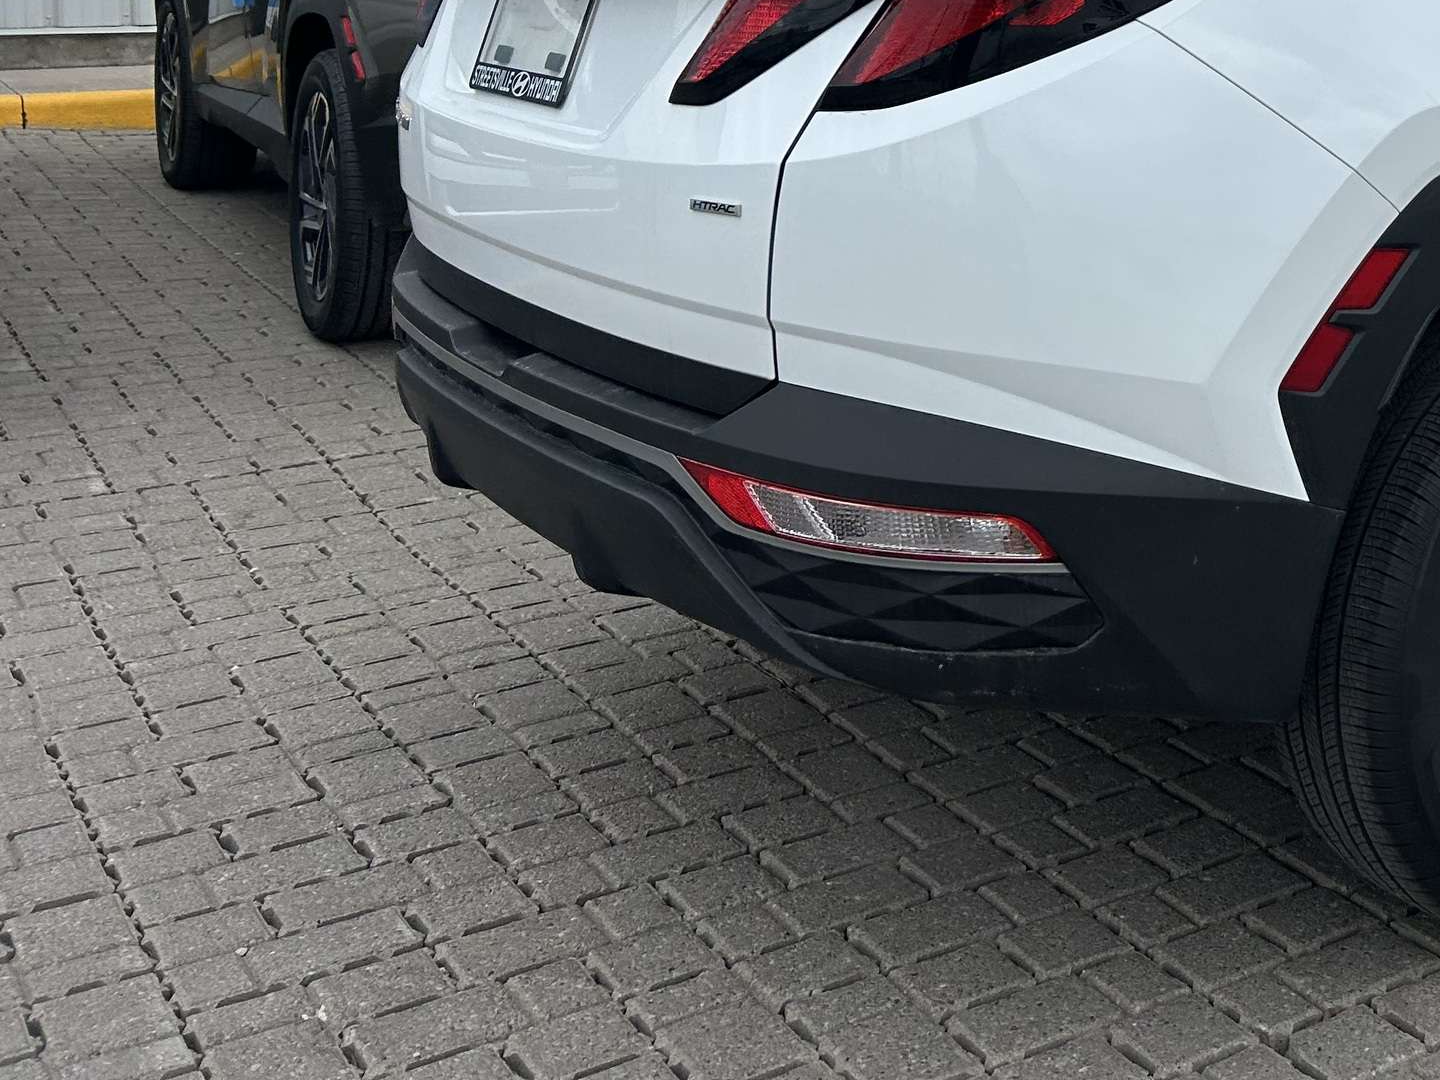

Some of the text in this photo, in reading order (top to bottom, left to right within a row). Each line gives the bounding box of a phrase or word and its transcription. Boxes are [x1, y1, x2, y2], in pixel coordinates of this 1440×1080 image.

[471, 64, 562, 102] STREETSVILLE HYUNDAI
[692, 200, 736, 214] HTRAC
